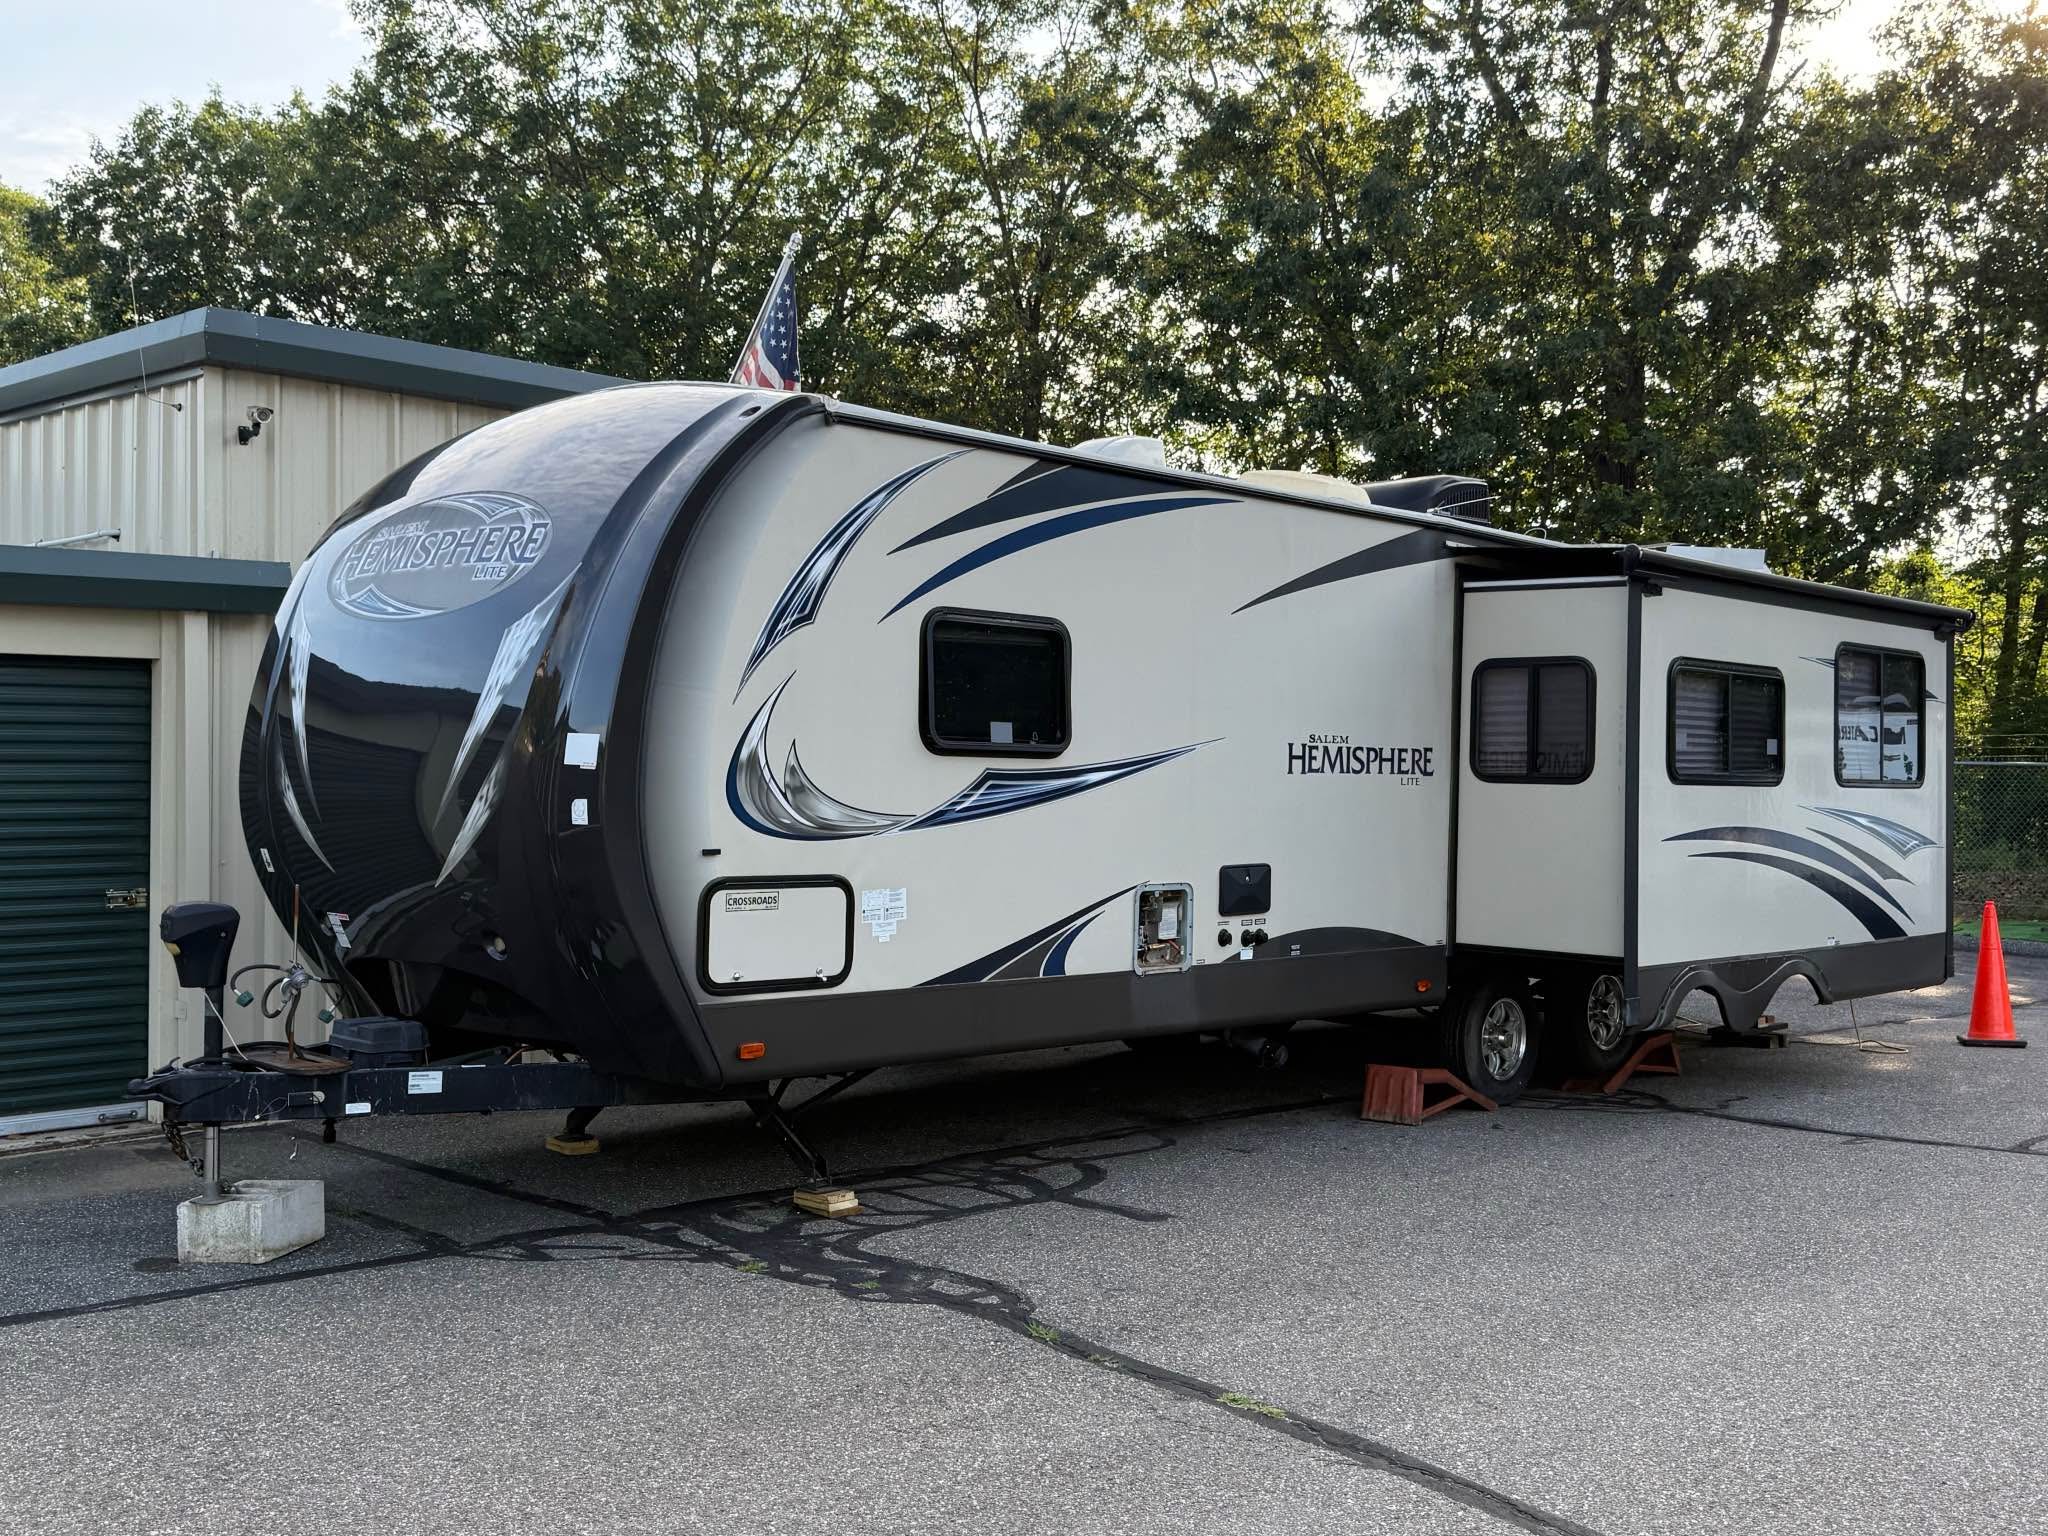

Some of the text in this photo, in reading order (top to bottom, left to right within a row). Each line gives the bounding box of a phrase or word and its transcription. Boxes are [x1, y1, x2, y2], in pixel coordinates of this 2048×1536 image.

[337, 521, 551, 581] HEMISPHERE
[472, 564, 508, 581] LITE
[1308, 734, 1350, 744] SALEM
[1287, 743, 1434, 776] HEMISPHERE
[1400, 777, 1421, 786] LITE
[727, 896, 778, 907] CROSSROADS
